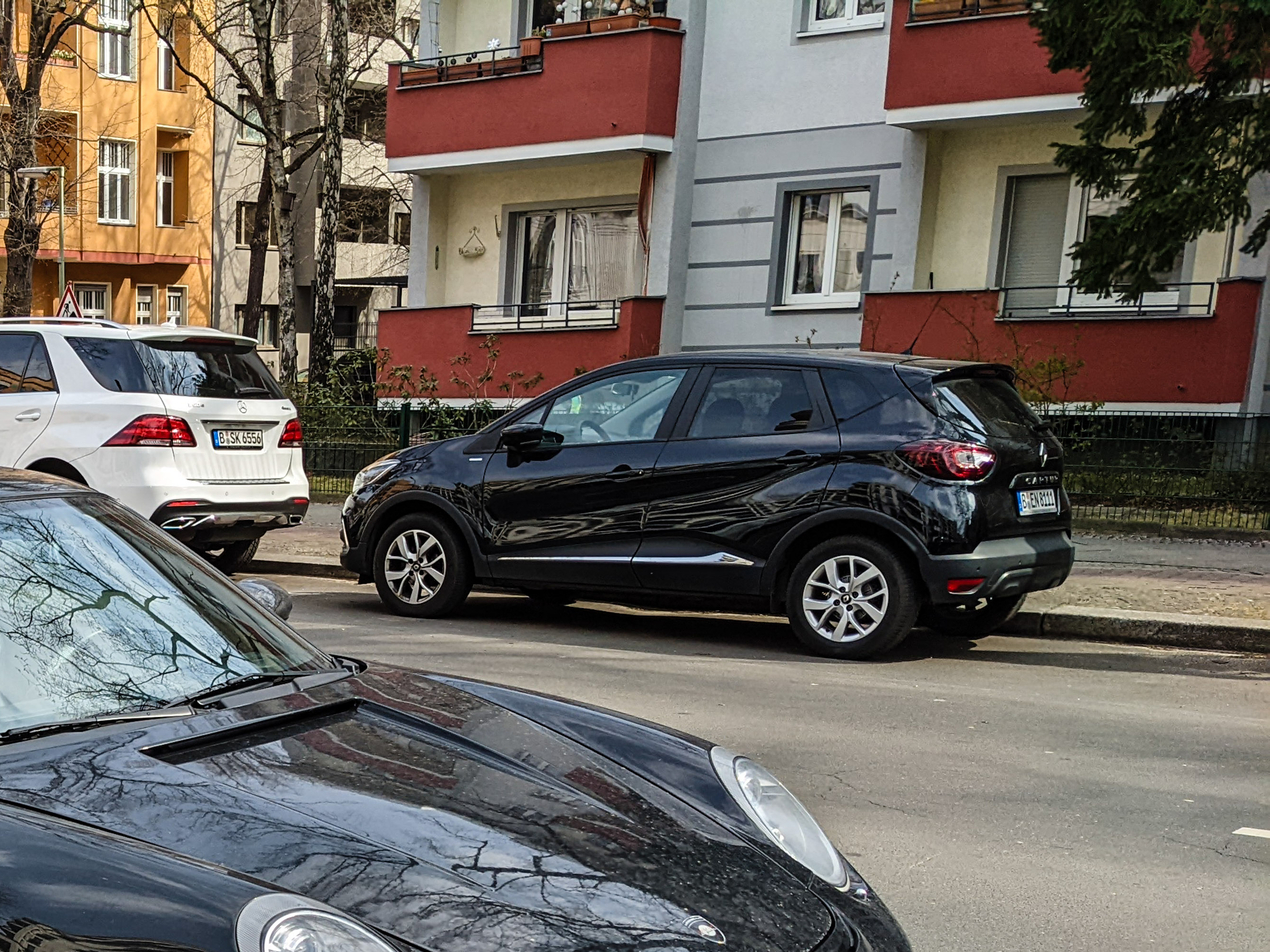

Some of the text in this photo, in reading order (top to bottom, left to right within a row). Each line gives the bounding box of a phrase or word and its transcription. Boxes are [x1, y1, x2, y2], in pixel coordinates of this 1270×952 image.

[219, 432, 261, 444] B SK 6556
[1022, 494, 1026, 508] B
